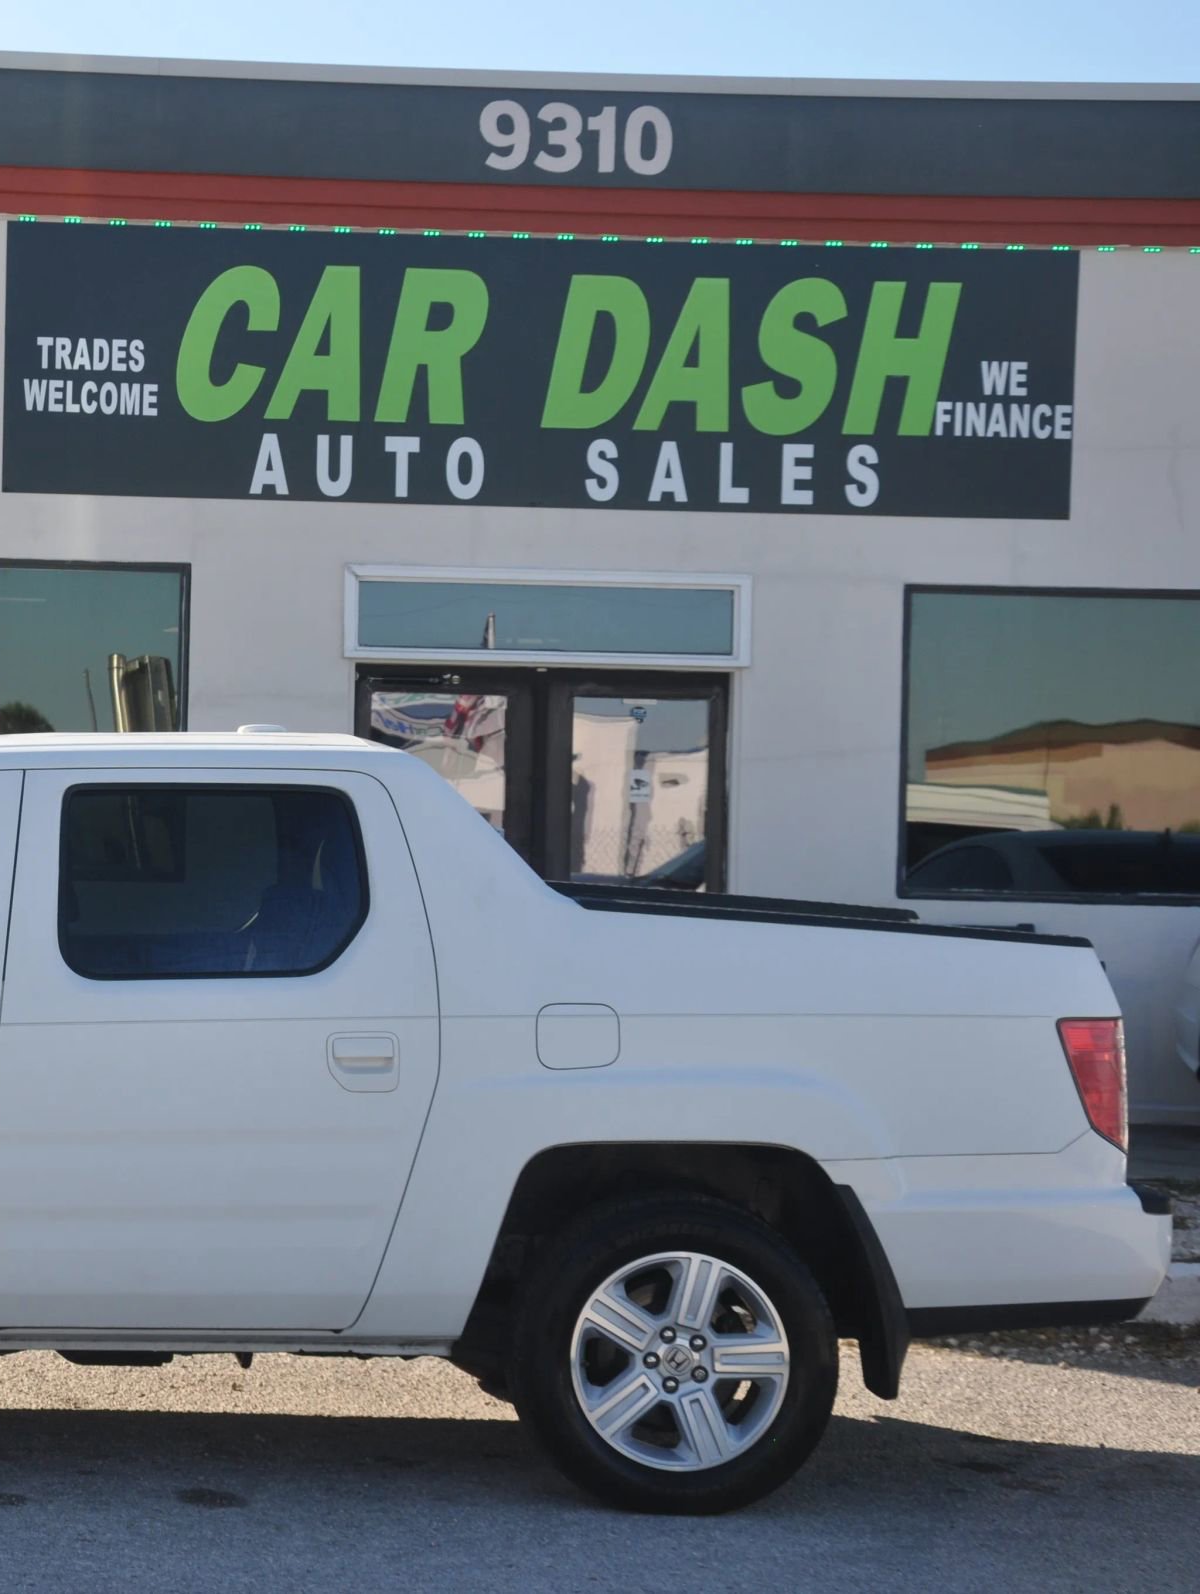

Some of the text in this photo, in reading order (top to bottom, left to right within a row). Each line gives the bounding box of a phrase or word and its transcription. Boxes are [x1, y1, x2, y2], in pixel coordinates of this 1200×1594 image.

[479, 99, 673, 176] 9310
[36, 336, 146, 373] TRADES
[177, 264, 963, 437] CAR DASH
[23, 378, 159, 417] WELCOME
[980, 360, 1029, 397] WE
[934, 401, 1073, 440] FINANCE
[247, 432, 881, 508] AUTO SALES
